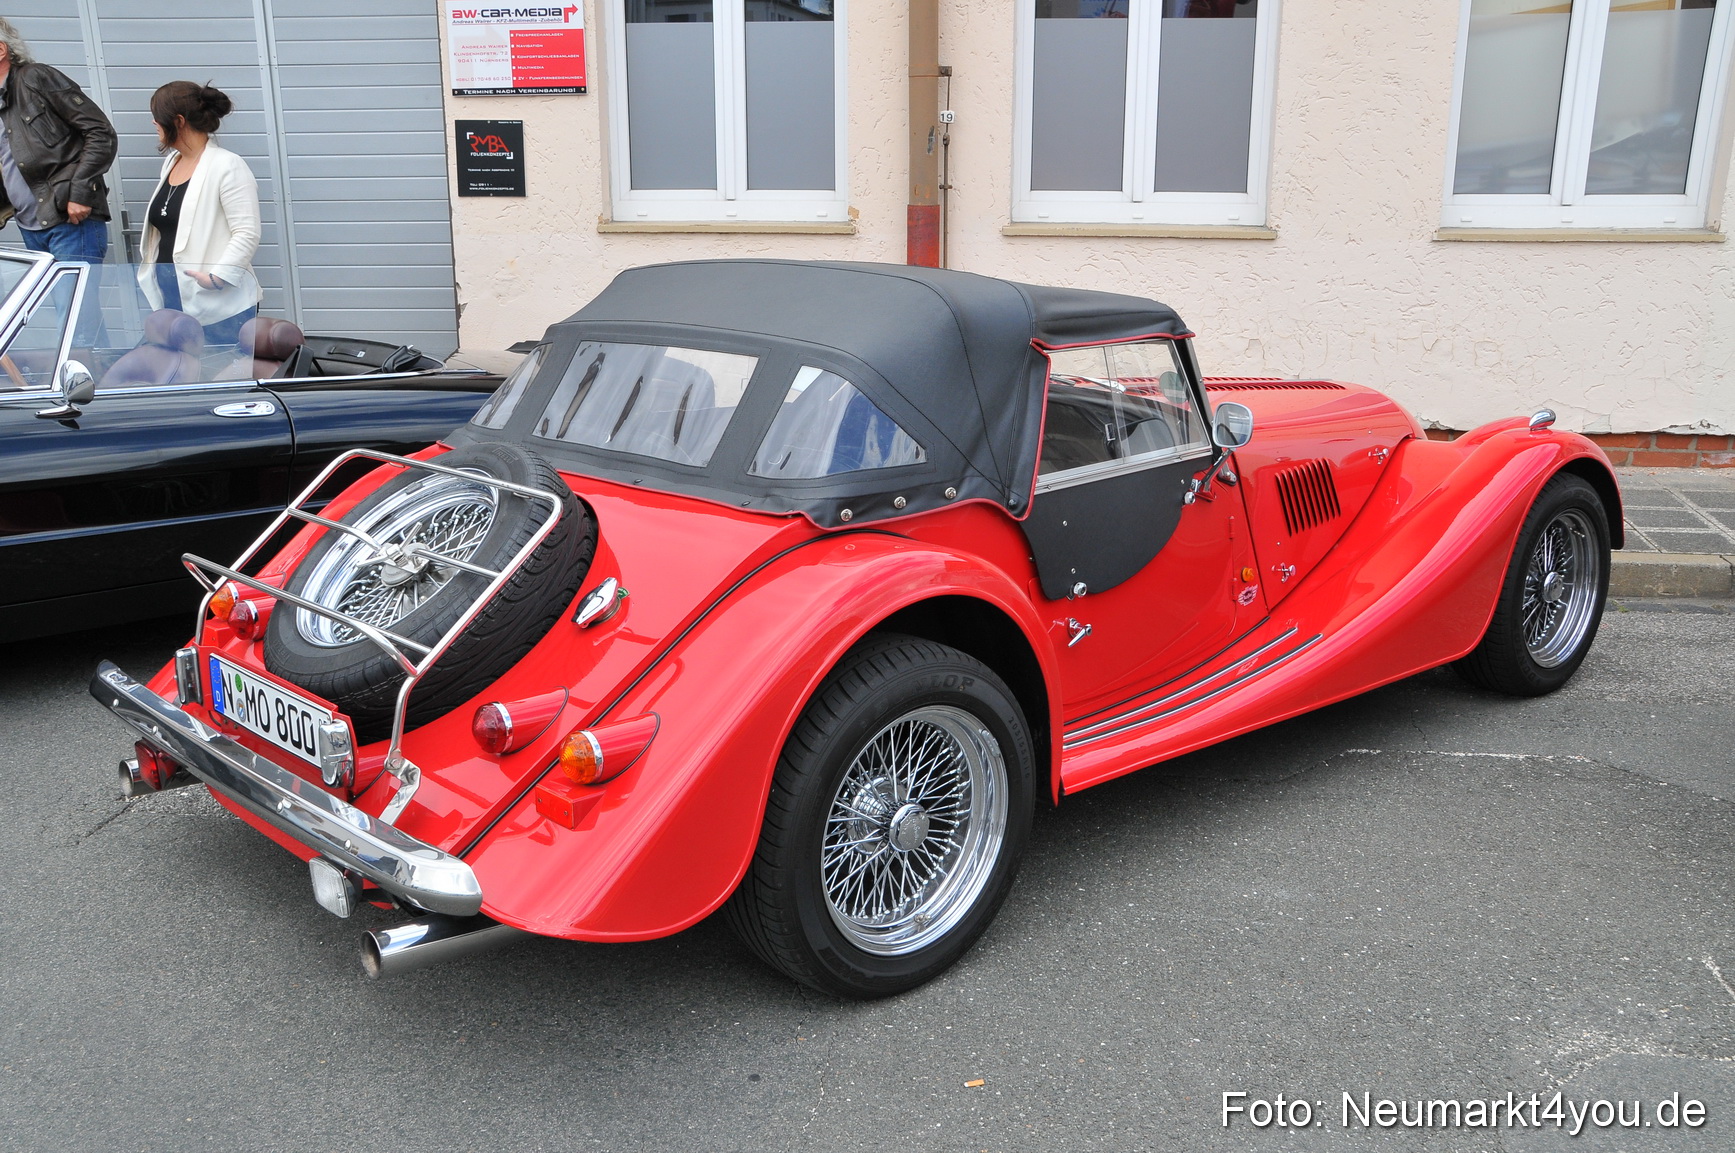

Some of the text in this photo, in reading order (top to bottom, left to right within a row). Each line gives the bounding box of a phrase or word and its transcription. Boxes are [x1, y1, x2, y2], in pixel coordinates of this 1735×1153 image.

[941, 113, 953, 122] 19
[469, 135, 510, 152] RMBA
[220, 668, 316, 757] N MO 800
